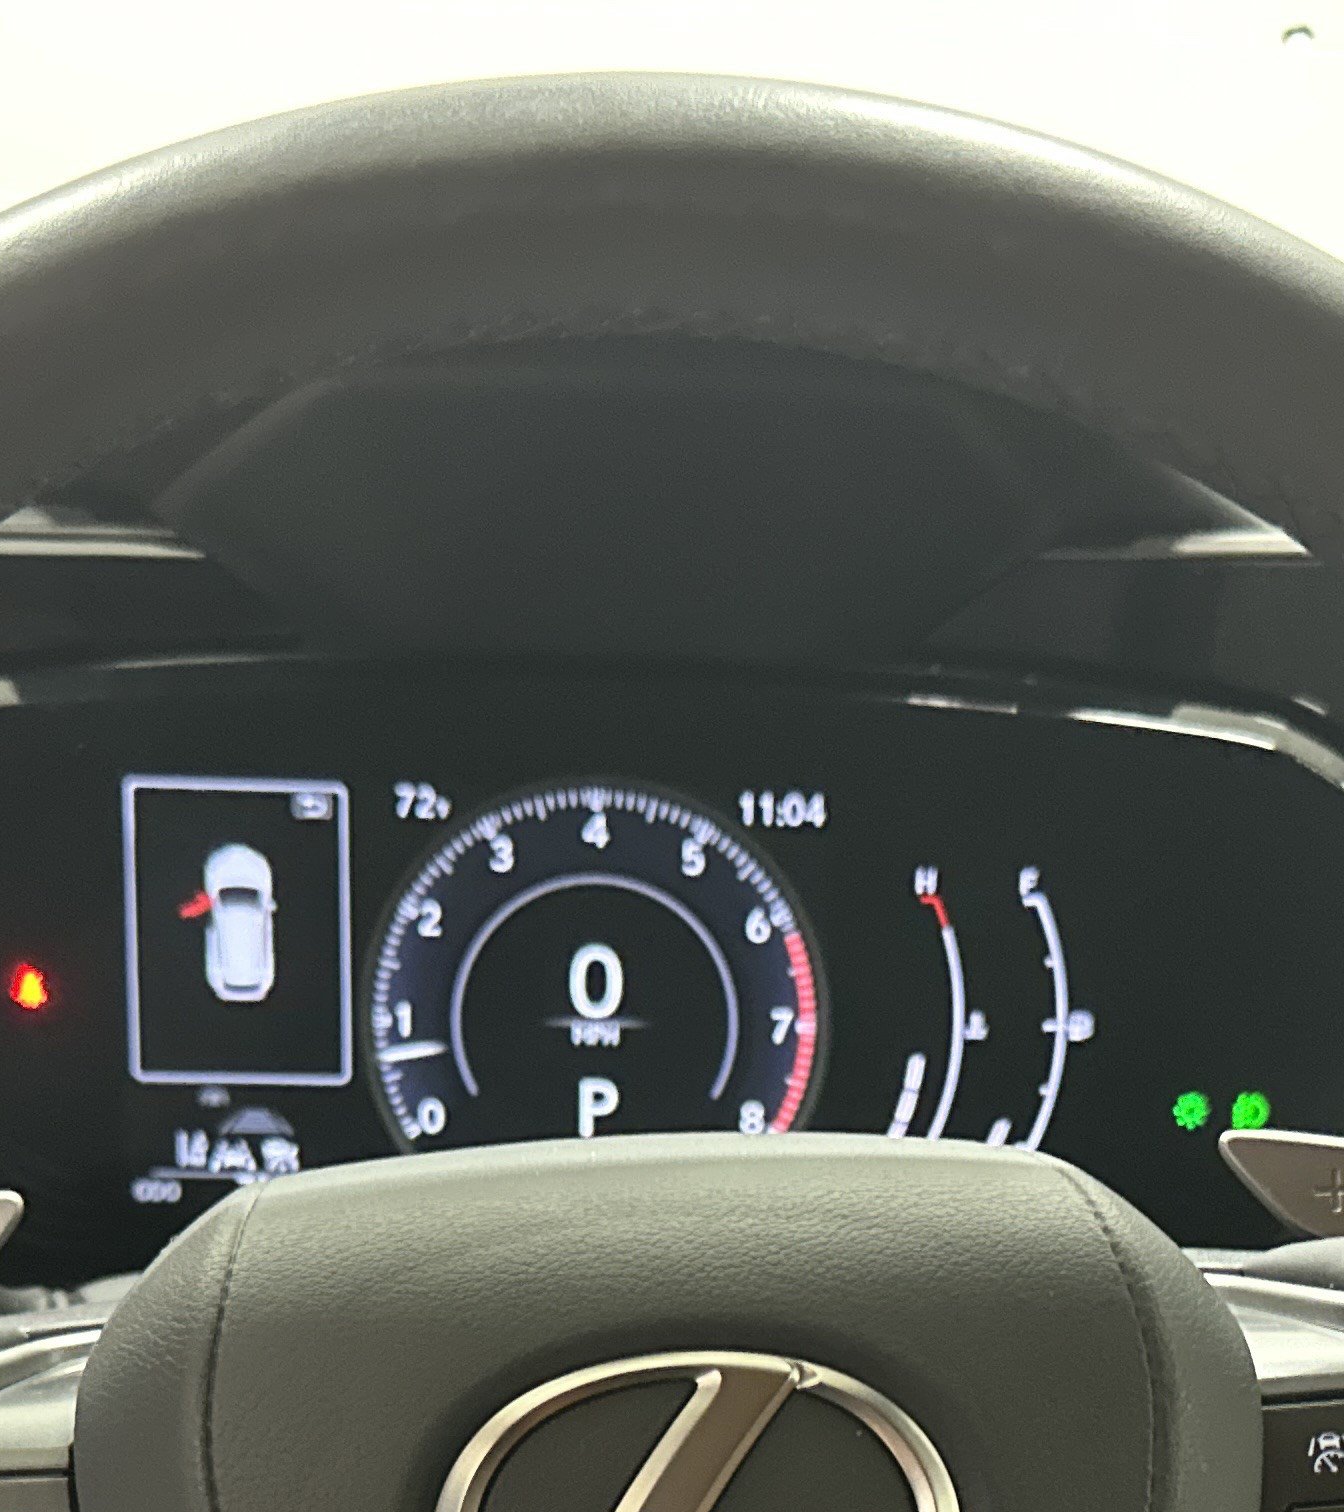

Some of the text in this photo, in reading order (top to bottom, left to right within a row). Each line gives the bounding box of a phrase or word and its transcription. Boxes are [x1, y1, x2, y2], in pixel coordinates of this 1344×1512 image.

[738, 790, 827, 829] 11:04
[580, 813, 611, 849] 4
[488, 837, 516, 874] 3
[681, 841, 707, 877] 5
[913, 865, 938, 894] H
[1018, 866, 1040, 894] F
[416, 902, 443, 938] 2
[744, 908, 771, 944] 6
[569, 943, 624, 1020] 0
[392, 1001, 413, 1036] 1
[769, 1009, 795, 1045] 7
[417, 1098, 446, 1136] 0
[577, 1076, 620, 1139] P
[738, 1101, 765, 1135] 8
